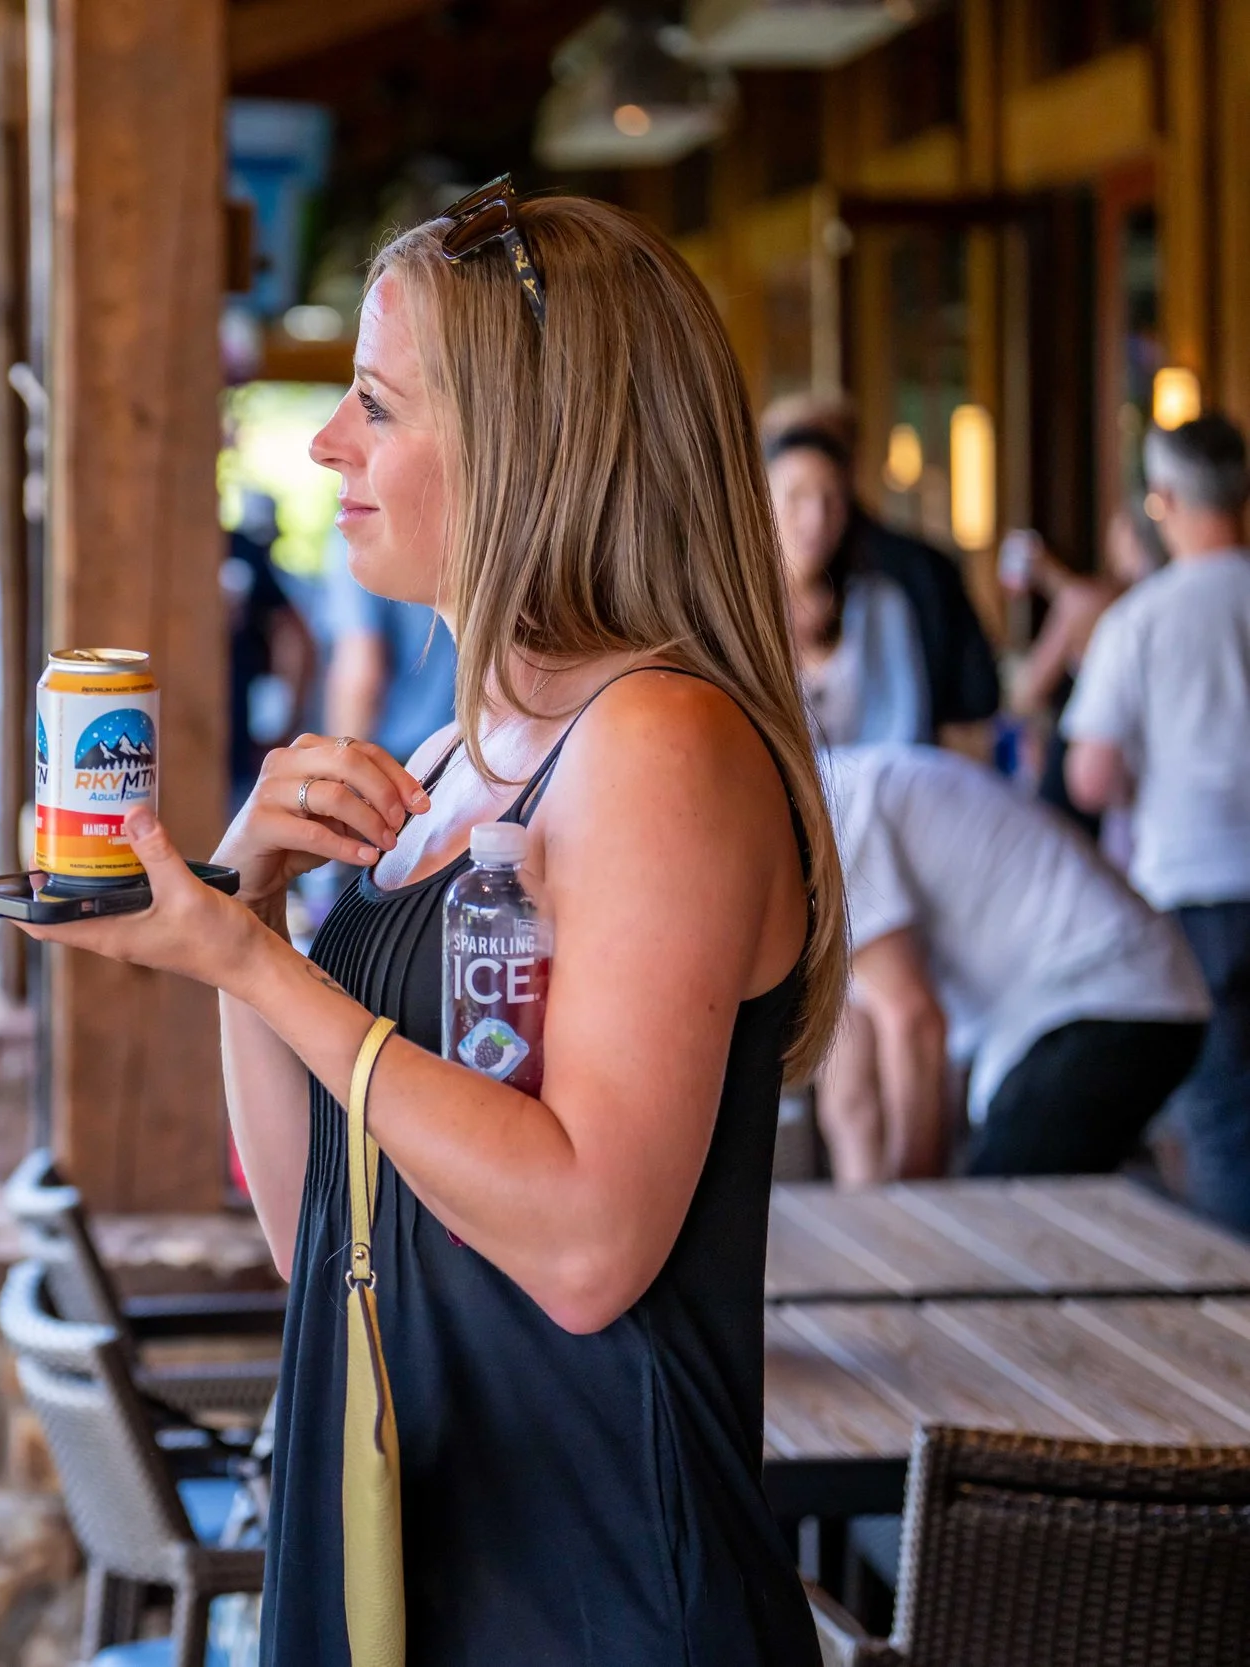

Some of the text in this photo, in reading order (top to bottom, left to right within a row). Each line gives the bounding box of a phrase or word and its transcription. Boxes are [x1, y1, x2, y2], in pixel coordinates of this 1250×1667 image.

[75, 769, 156, 798] RKYMTN
[89, 792, 120, 801] ADULT
[82, 824, 109, 836] MANGO
[454, 932, 534, 955] SPARKLING
[454, 955, 534, 1004] ICE
